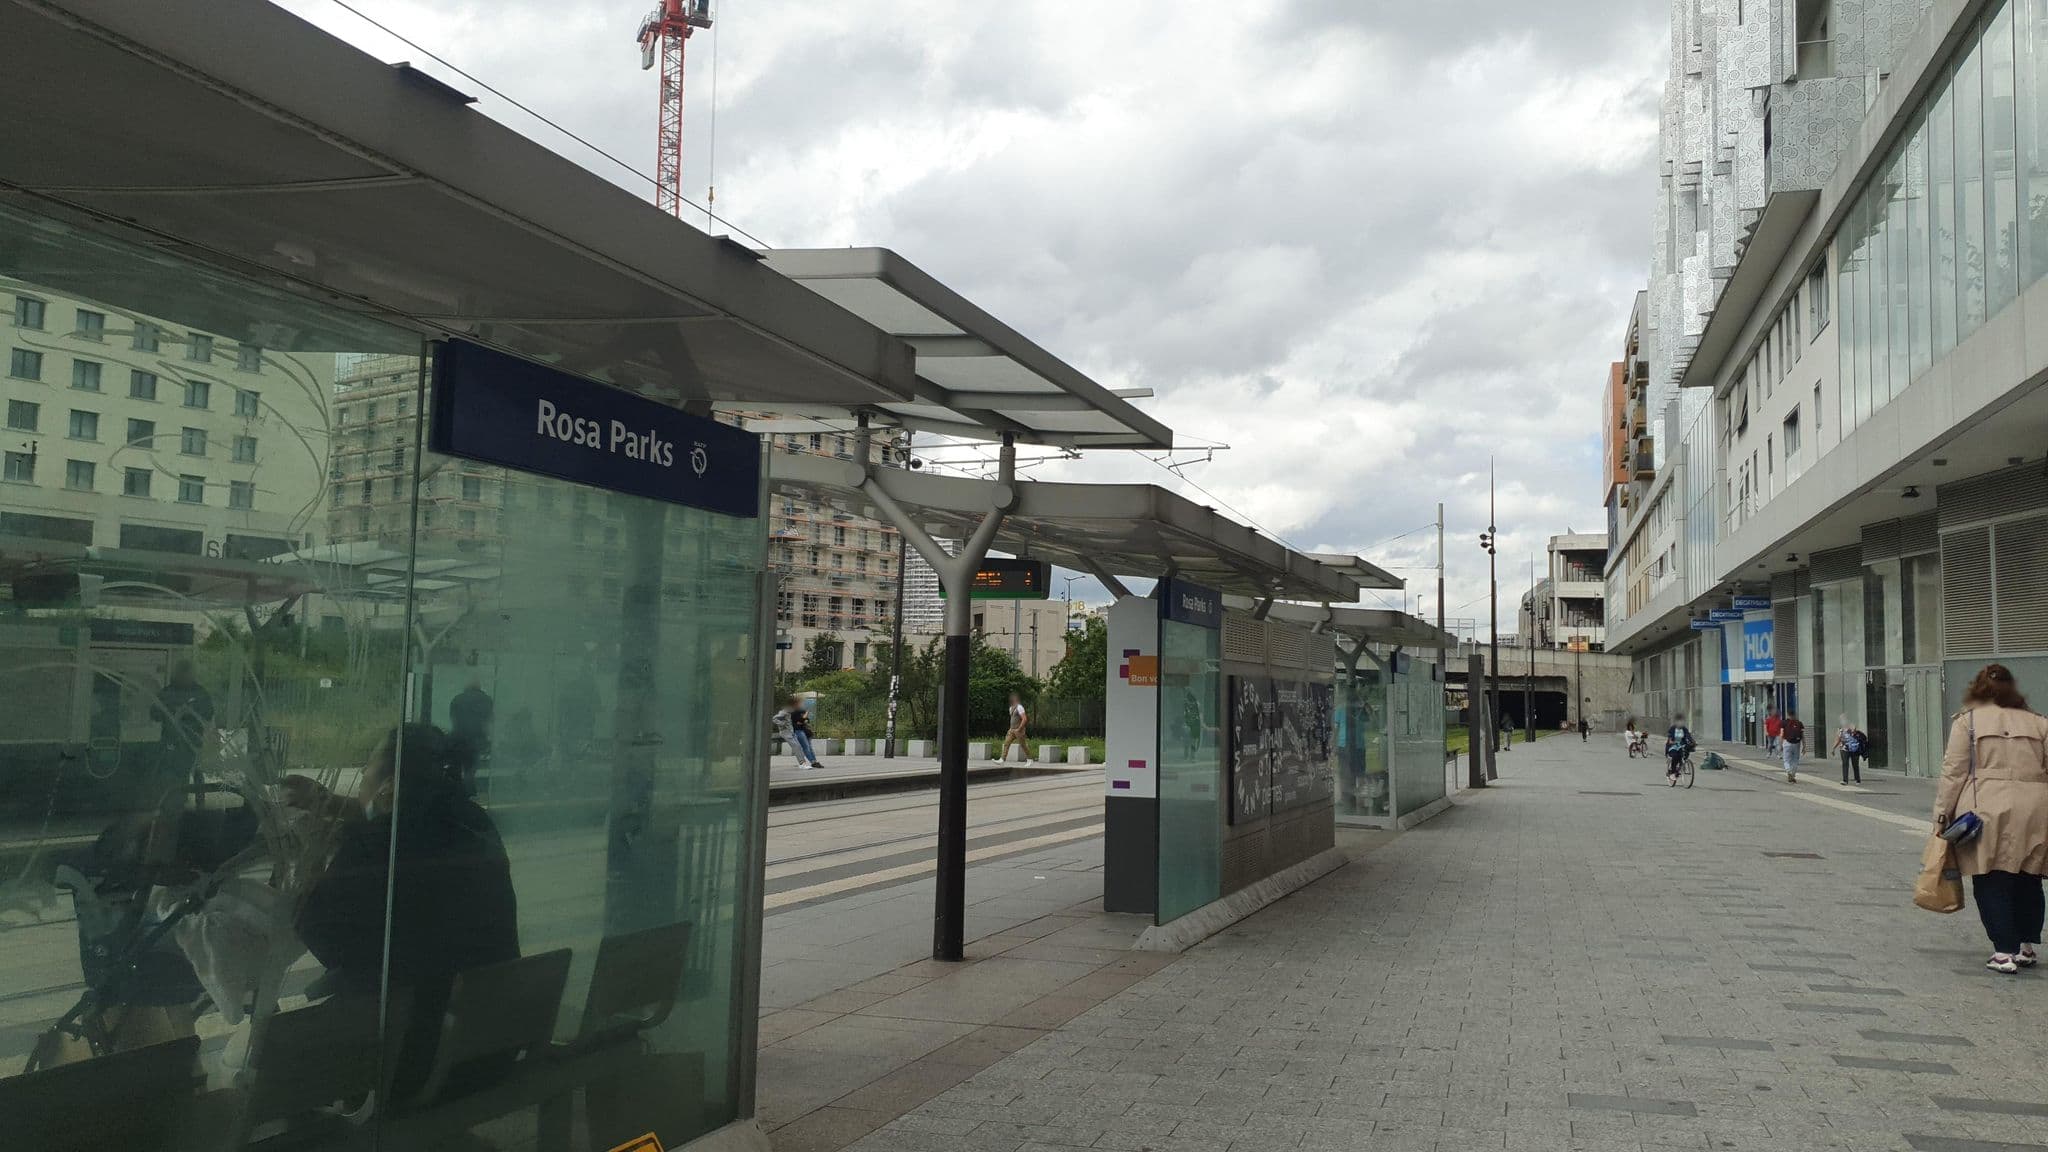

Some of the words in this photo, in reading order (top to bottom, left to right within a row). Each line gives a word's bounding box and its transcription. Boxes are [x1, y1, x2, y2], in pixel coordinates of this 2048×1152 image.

[537, 399, 601, 449] Rosa
[610, 420, 673, 467] Parks
[1131, 674, 1148, 682] Bon
